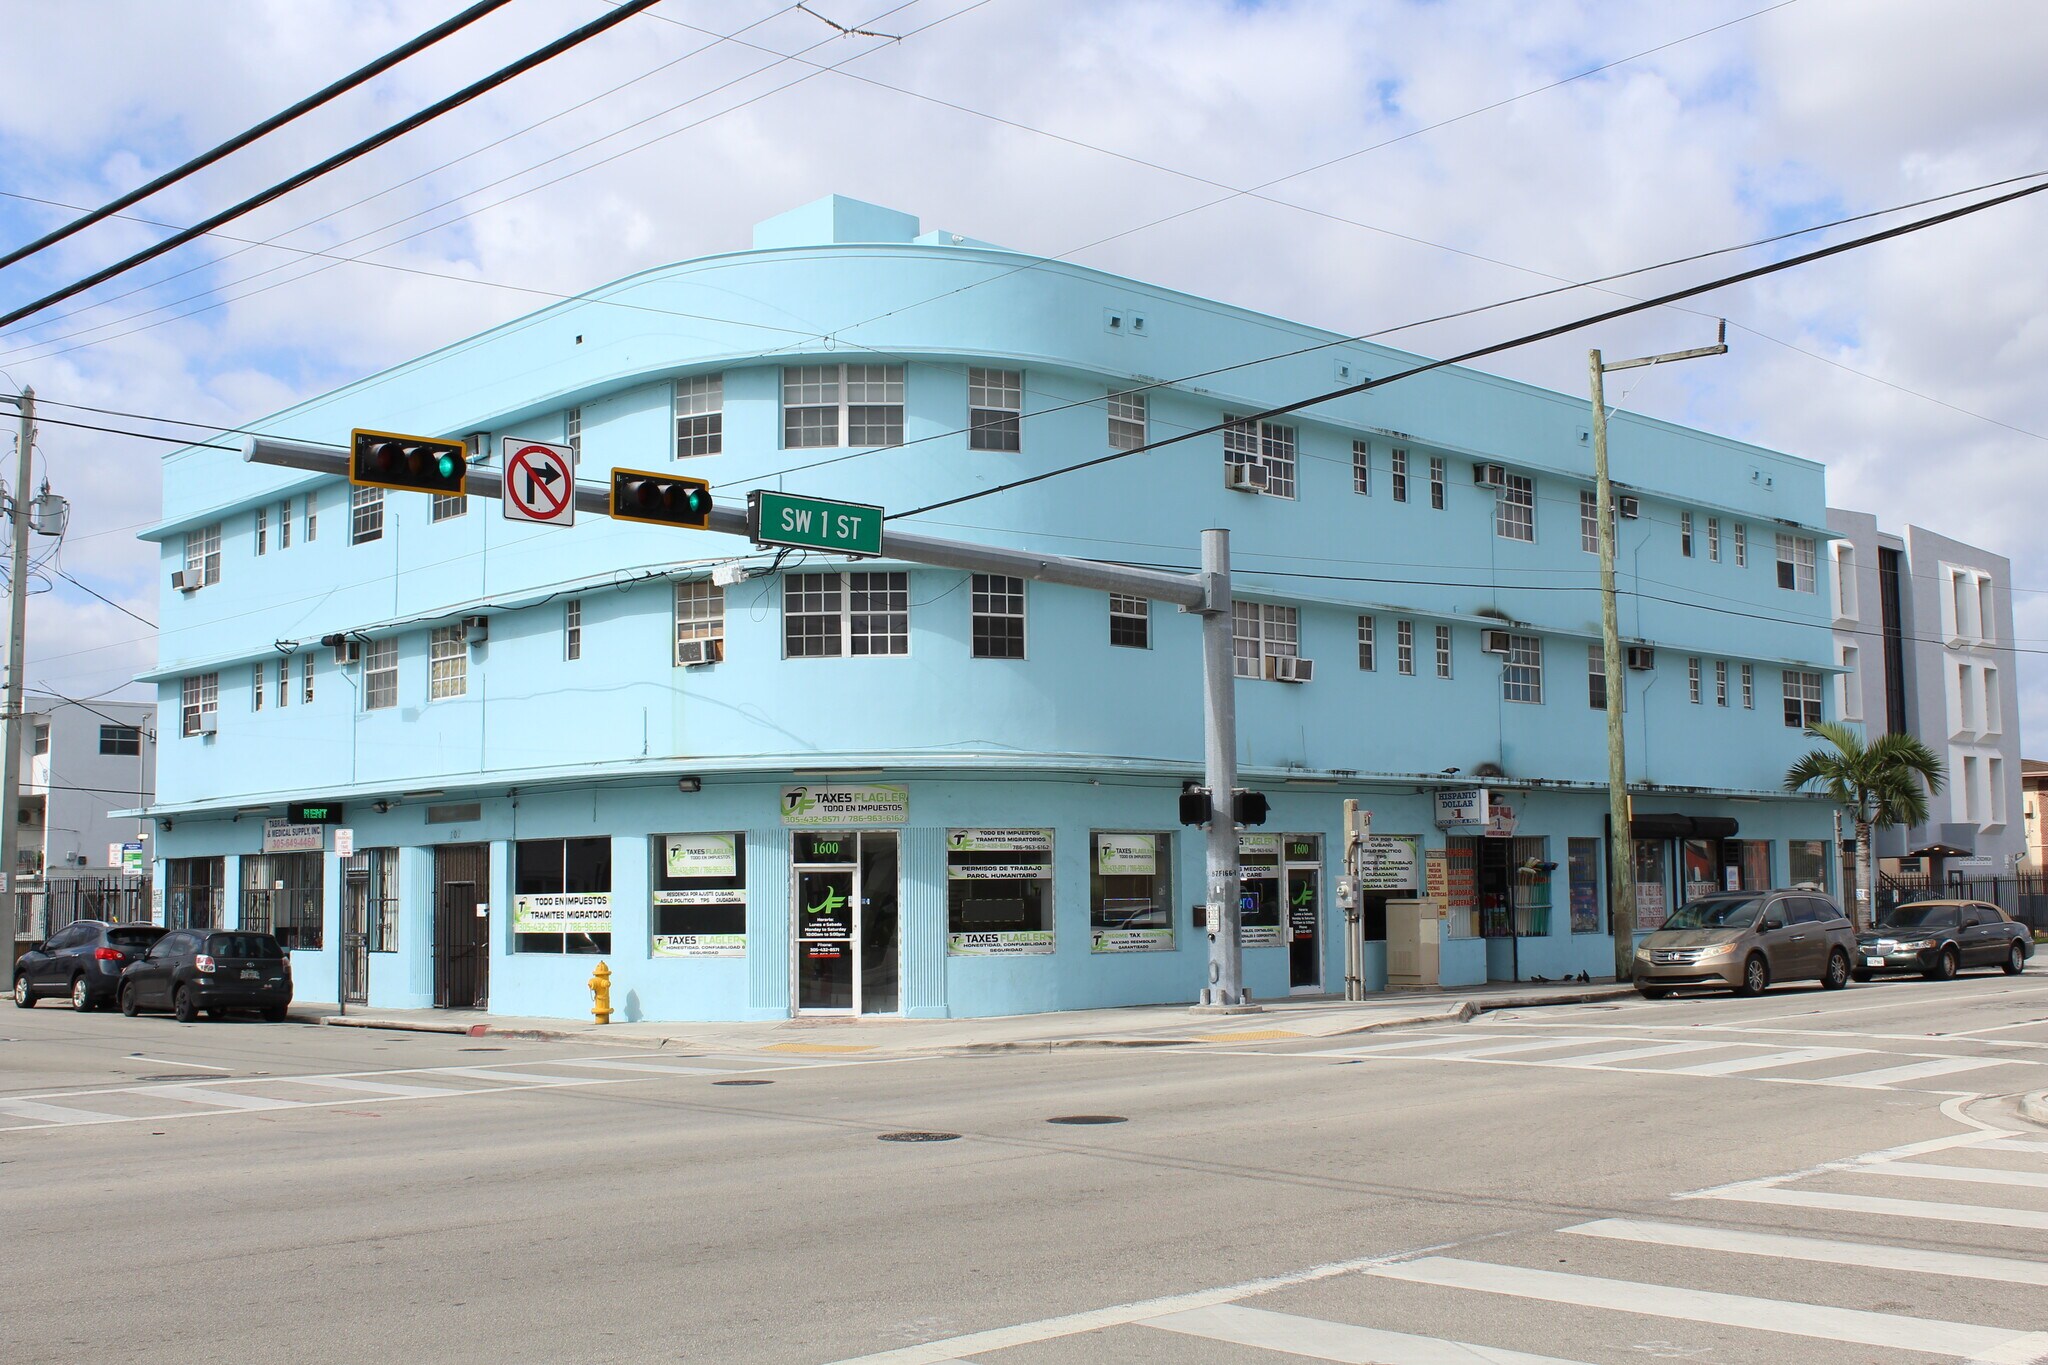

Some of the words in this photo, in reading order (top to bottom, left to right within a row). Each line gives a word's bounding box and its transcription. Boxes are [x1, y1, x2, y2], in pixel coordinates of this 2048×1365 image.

[781, 507, 812, 534] SW
[821, 510, 829, 538] 1
[836, 515, 862, 540] ST
[815, 793, 852, 803] TAXES
[854, 792, 907, 803] FLAGLER
[1439, 791, 1477, 800] HISPANIC
[1442, 800, 1474, 808] DOLLAR
[303, 808, 328, 819] RENT
[848, 814, 904, 822] 786-963-6162
[272, 828, 292, 837] MEDICAL
[292, 827, 310, 837] SUPPLY,
[311, 825, 321, 834] INC.
[272, 838, 316, 849] 305-649-4460
[813, 842, 839, 855] 1600
[1294, 843, 1309, 855] 1600
[535, 897, 554, 906] TODO
[554, 897, 564, 906] EN
[565, 896, 607, 905] IMPUESTOS
[530, 911, 565, 919] TRAMITES
[667, 936, 697, 945] TAXES
[698, 935, 741, 944] FLAGLER
[965, 934, 998, 943] TAXES
[1000, 932, 1046, 942] FLAGLER
